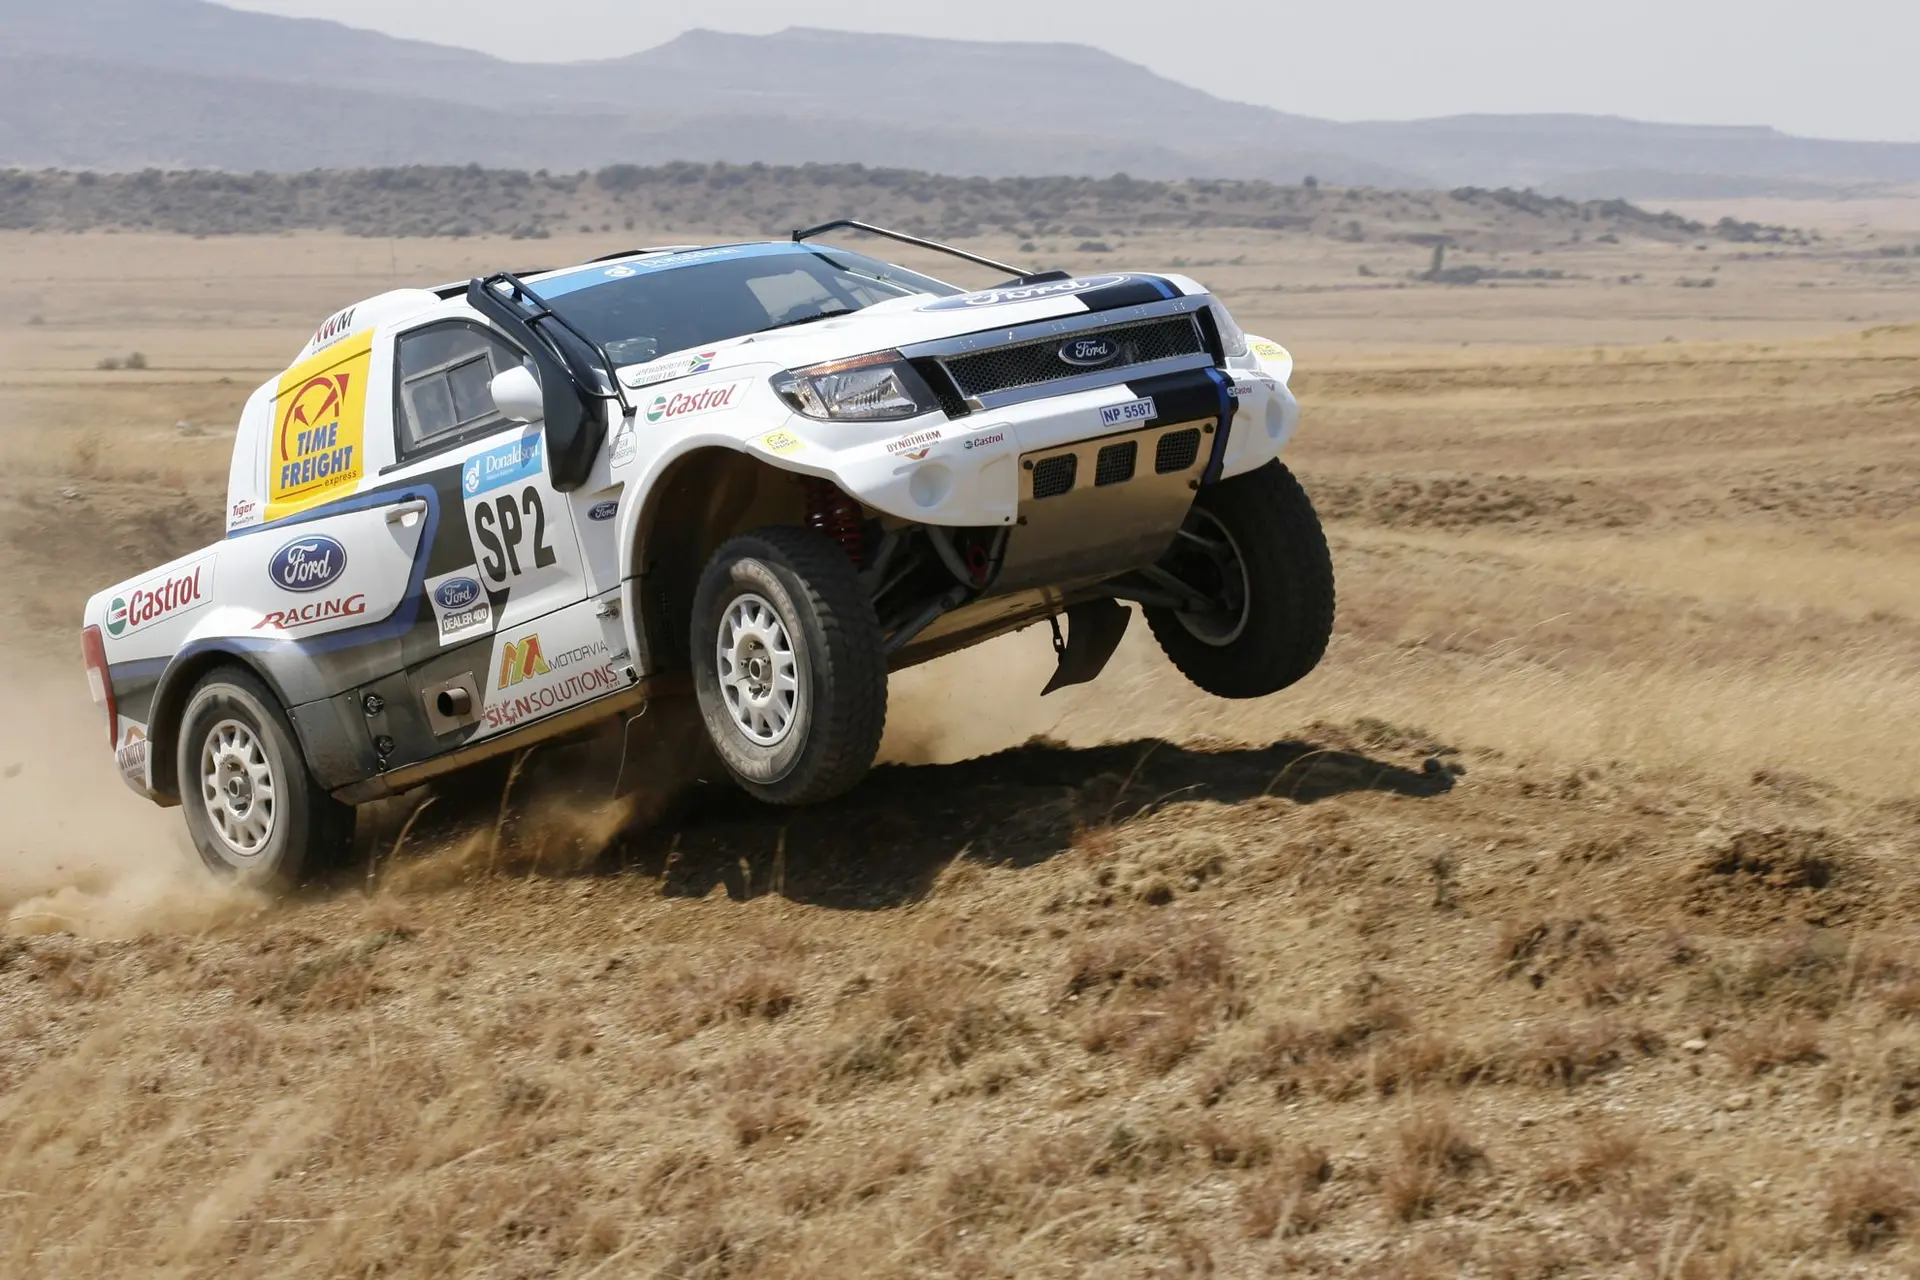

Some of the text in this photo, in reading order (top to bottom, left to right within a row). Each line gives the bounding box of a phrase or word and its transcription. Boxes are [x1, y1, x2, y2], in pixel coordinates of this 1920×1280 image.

[965, 278, 1091, 305] Ford
[1075, 340, 1108, 358] Ford
[665, 383, 737, 418] Castrol
[1103, 402, 1153, 423] NP 5587
[296, 421, 339, 457] TIME
[886, 430, 942, 453] DYNOTHERM
[973, 432, 1005, 448] Castrol
[280, 445, 354, 490] FREIGHT
[486, 442, 540, 474] Donaldson
[324, 470, 357, 487] express
[232, 502, 256, 518] Tiger
[595, 503, 618, 519] Ford
[474, 485, 557, 583] SP2
[284, 543, 332, 584] Ford
[128, 565, 202, 627] Castrol
[444, 582, 473, 606] Ford
[251, 593, 367, 630] RACING
[442, 608, 488, 632] DEALER 400
[548, 641, 609, 671] MOTORVIA
